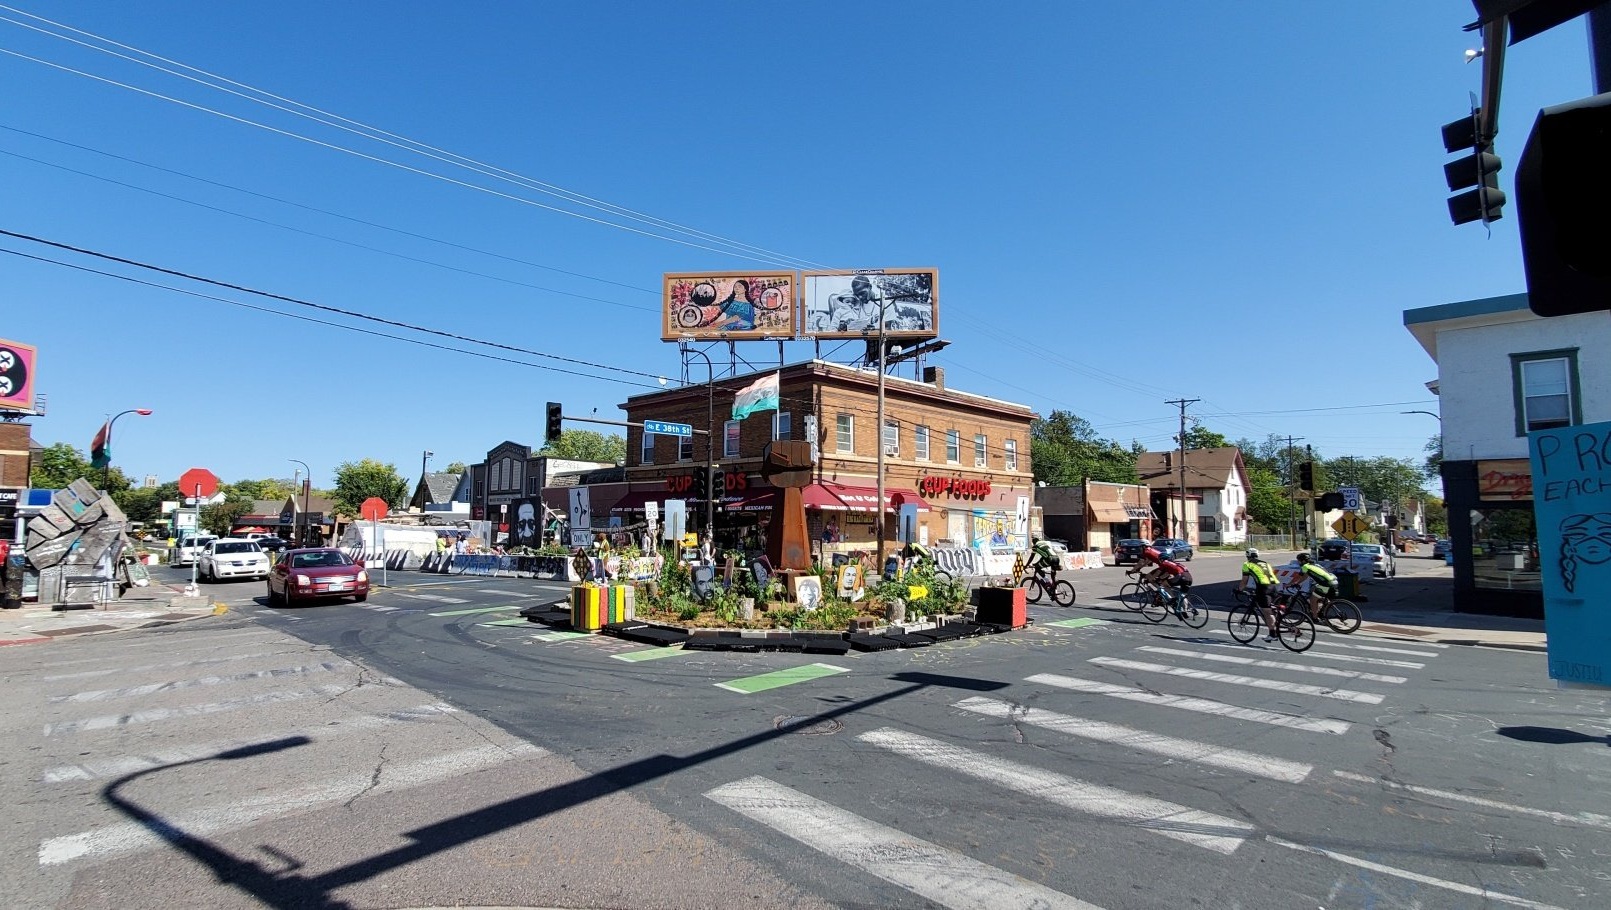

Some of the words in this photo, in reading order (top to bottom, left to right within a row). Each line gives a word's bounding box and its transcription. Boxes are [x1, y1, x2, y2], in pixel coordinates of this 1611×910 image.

[655, 423, 660, 431] E
[663, 424, 680, 433] 38th
[666, 475, 693, 493] CUP
[923, 475, 949, 494] CUP
[952, 478, 992, 496] FOODS
[574, 534, 588, 543] ONLY
